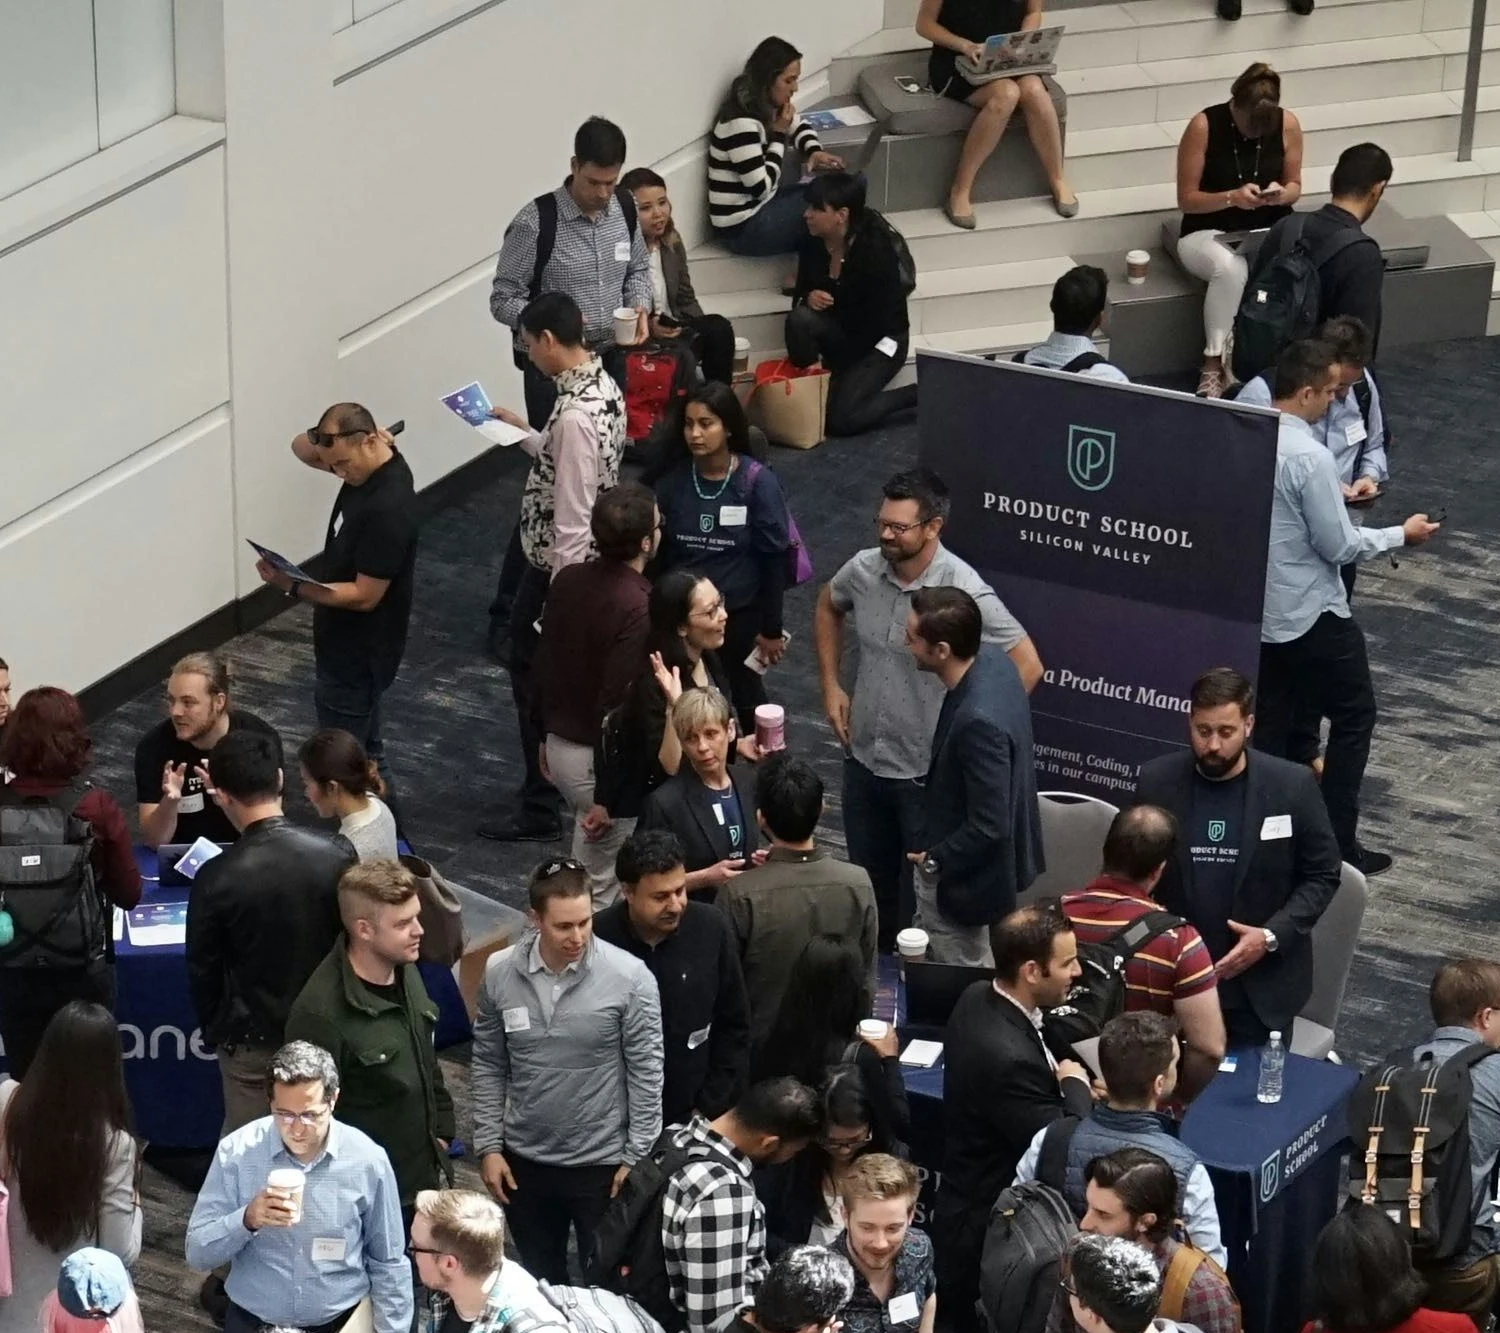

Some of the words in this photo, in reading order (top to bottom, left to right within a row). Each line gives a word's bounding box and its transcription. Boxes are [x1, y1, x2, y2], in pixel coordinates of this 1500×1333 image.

[983, 492, 1090, 529] PRODUCT
[1099, 515, 1194, 549] SCHOOL
[1020, 529, 1085, 552] SILICON
[1092, 544, 1152, 566] VALLEY
[1059, 670, 1133, 702] Product
[1135, 686, 1193, 714] Mana
[1033, 744, 1084, 766] gement,
[1086, 754, 1133, 779] Coding,
[1047, 760, 1060, 773] in
[1062, 765, 1082, 779] our
[1085, 771, 1137, 794] campuse
[1285, 1114, 1328, 1160] PRODUCT
[1284, 1140, 1319, 1178] SCHOOL
